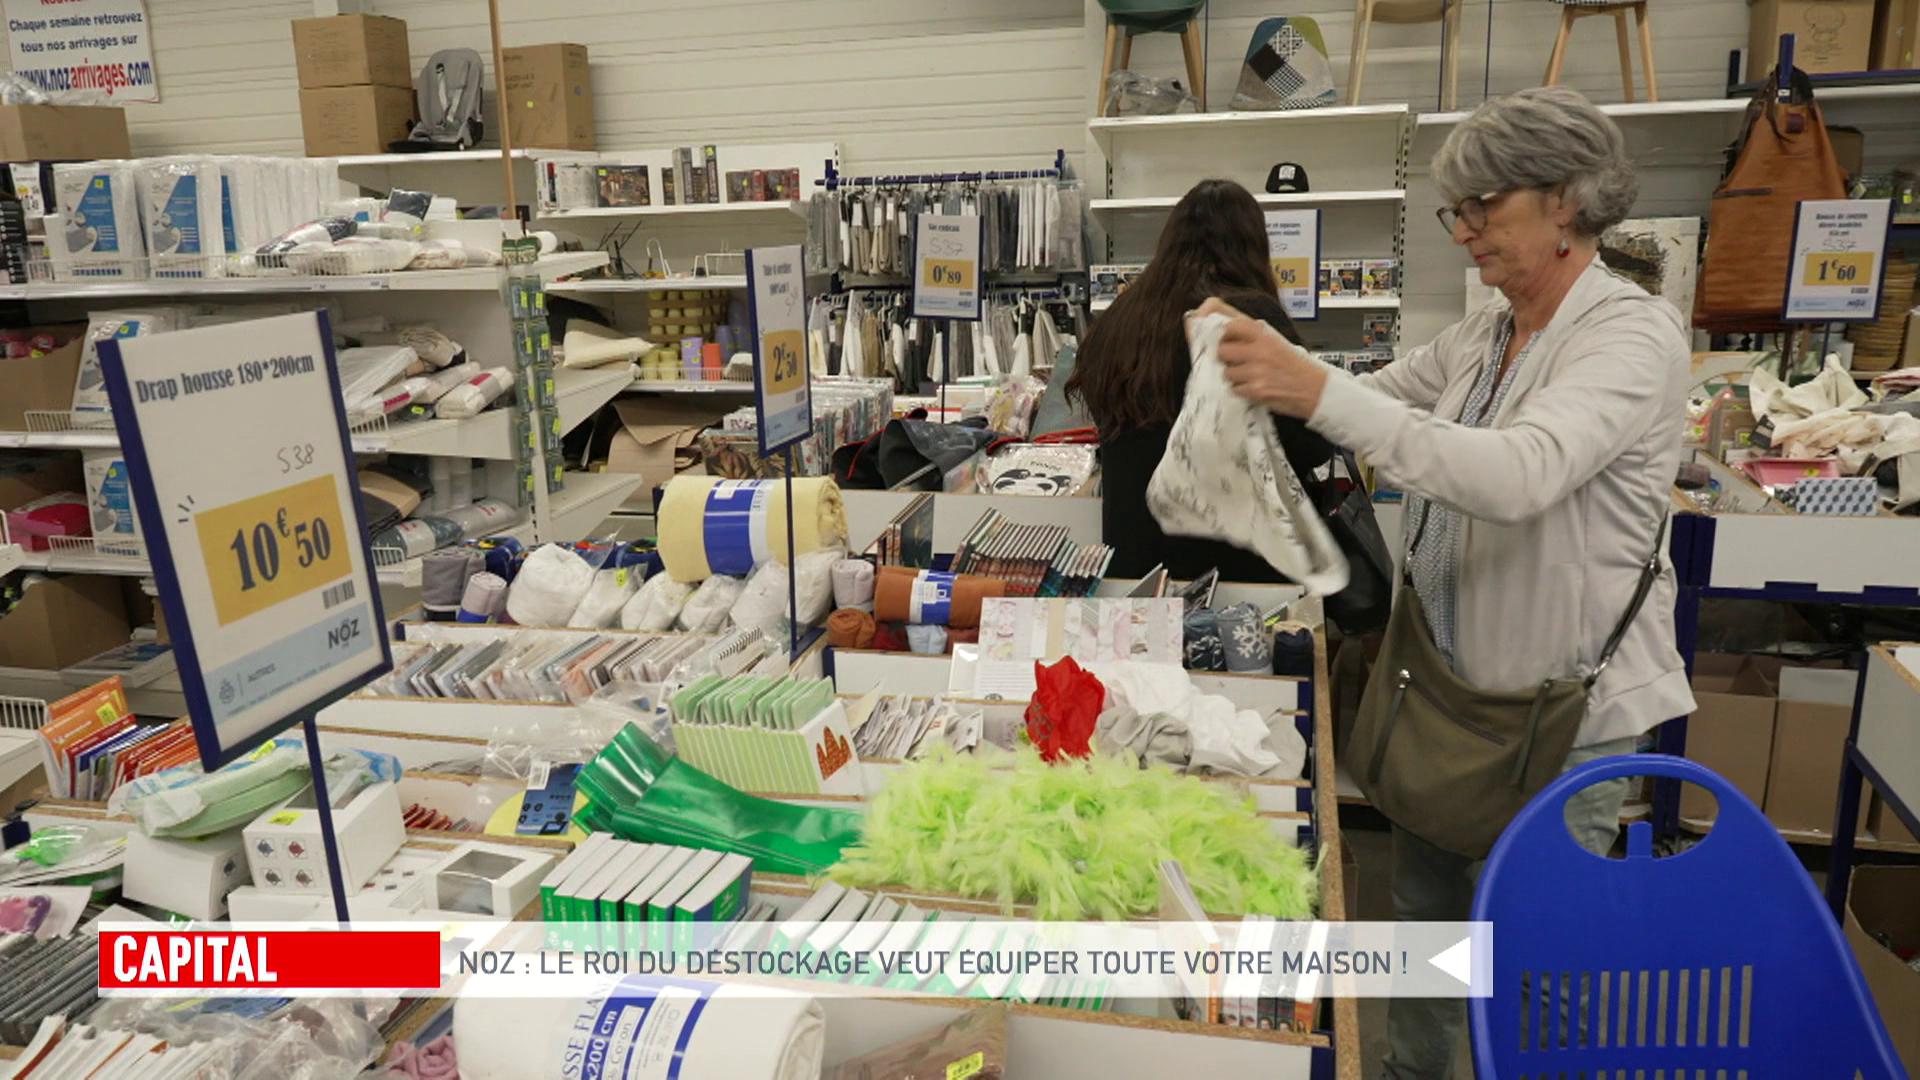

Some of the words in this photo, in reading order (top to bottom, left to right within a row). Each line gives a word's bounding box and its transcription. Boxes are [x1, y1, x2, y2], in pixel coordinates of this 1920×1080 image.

[9, 19, 47, 32] Chaque
[50, 15, 91, 28] semaine
[93, 12, 143, 25] retrouvez
[20, 42, 44, 52] tous
[47, 40, 66, 51] nos
[68, 36, 119, 50] arrivages
[121, 34, 138, 45] sur
[136, 377, 179, 403] Drap
[180, 367, 236, 395] housse
[277, 444, 315, 474] S38
